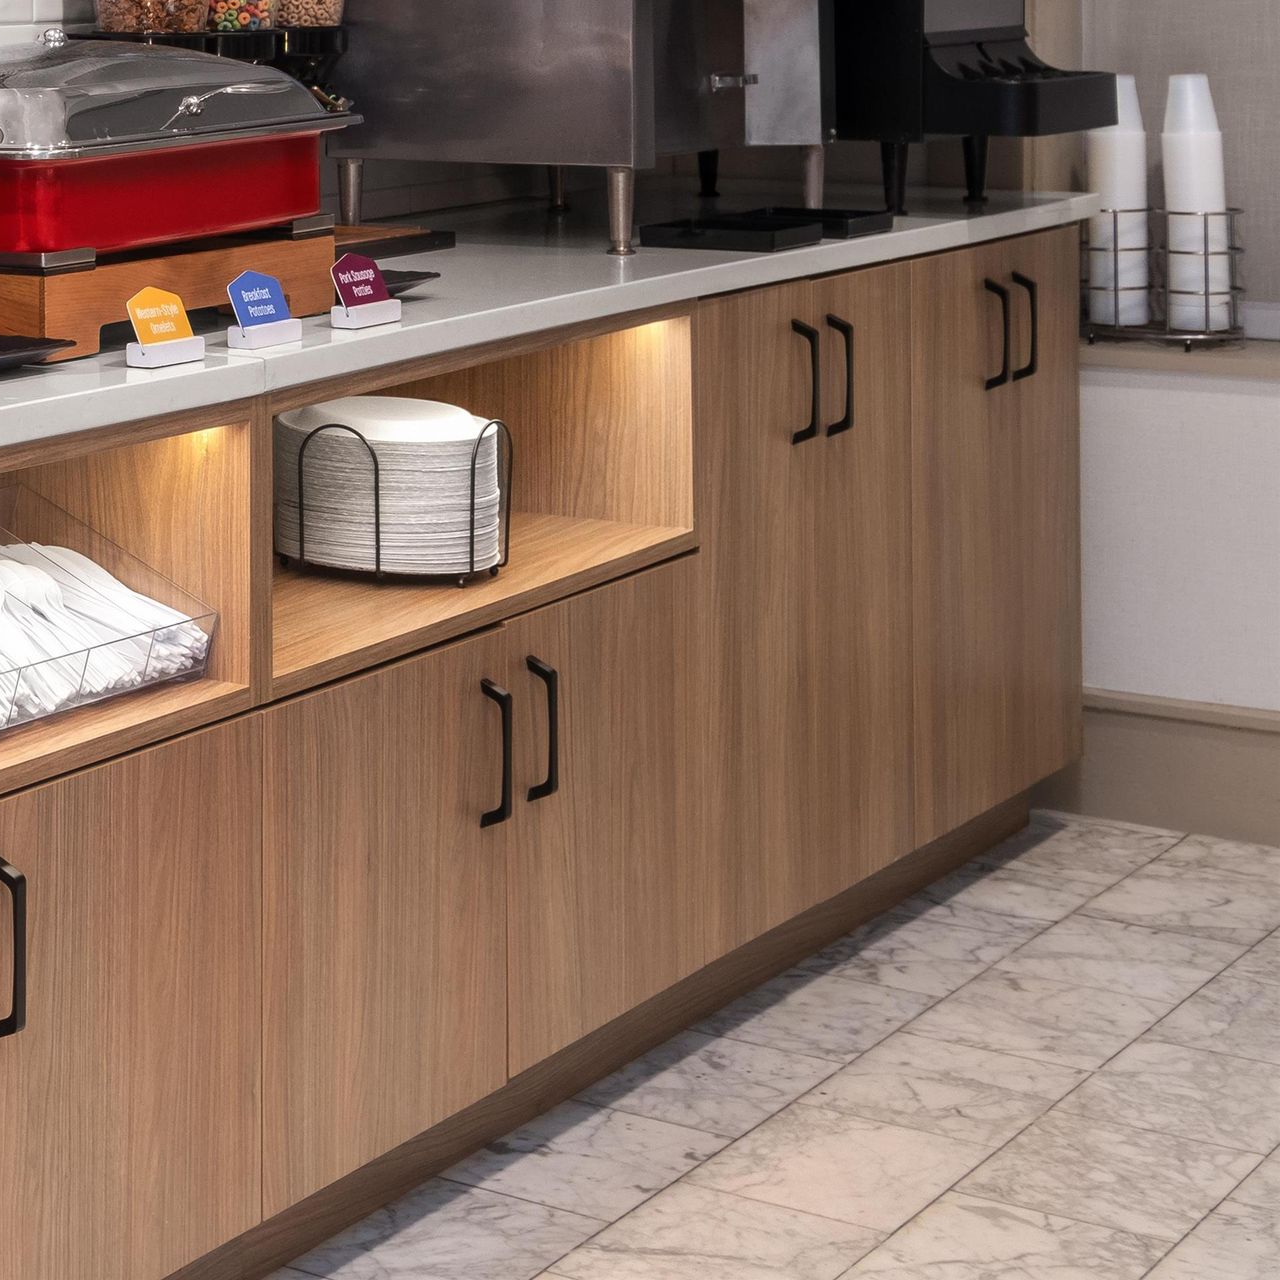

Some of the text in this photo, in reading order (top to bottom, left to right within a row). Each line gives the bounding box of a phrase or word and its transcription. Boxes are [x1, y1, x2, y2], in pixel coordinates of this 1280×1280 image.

[338, 268, 375, 284] Pork Sausage
[241, 287, 272, 302] Breakfast
[352, 284, 373, 297] Patties
[247, 304, 276, 317] Potatoes
